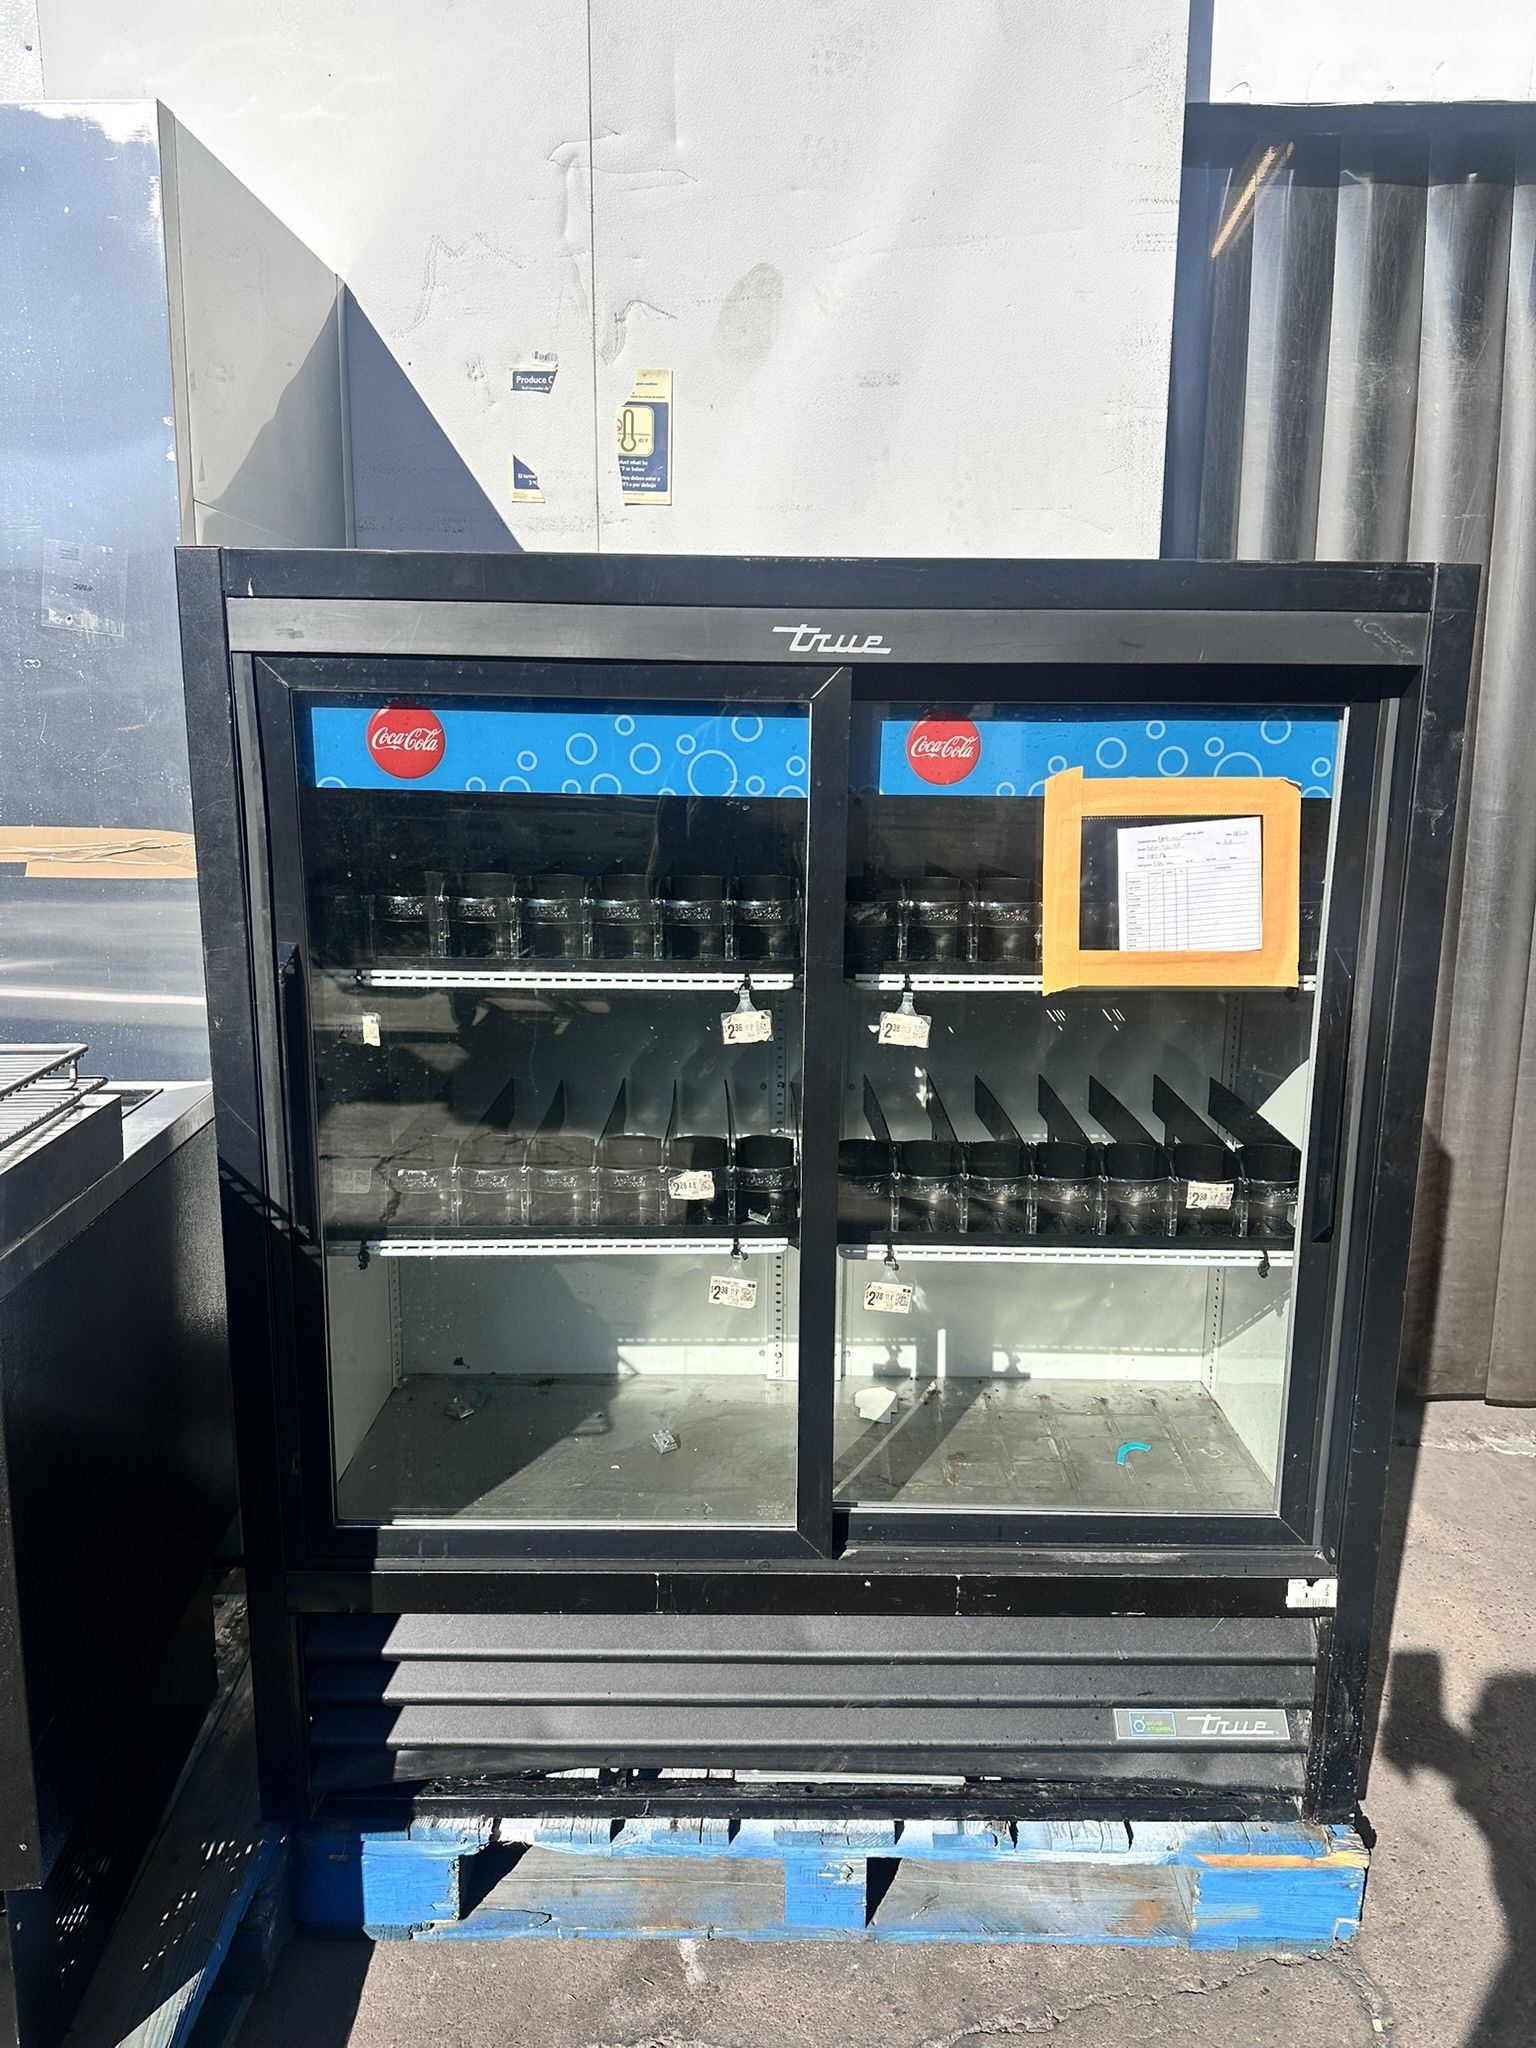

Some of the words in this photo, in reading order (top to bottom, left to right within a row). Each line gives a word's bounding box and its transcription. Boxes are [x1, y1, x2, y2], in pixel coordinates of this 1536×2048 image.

[515, 375, 547, 384] Produce
[371, 726, 443, 752] Coca-Cola
[910, 735, 979, 758] Coca-Cola
